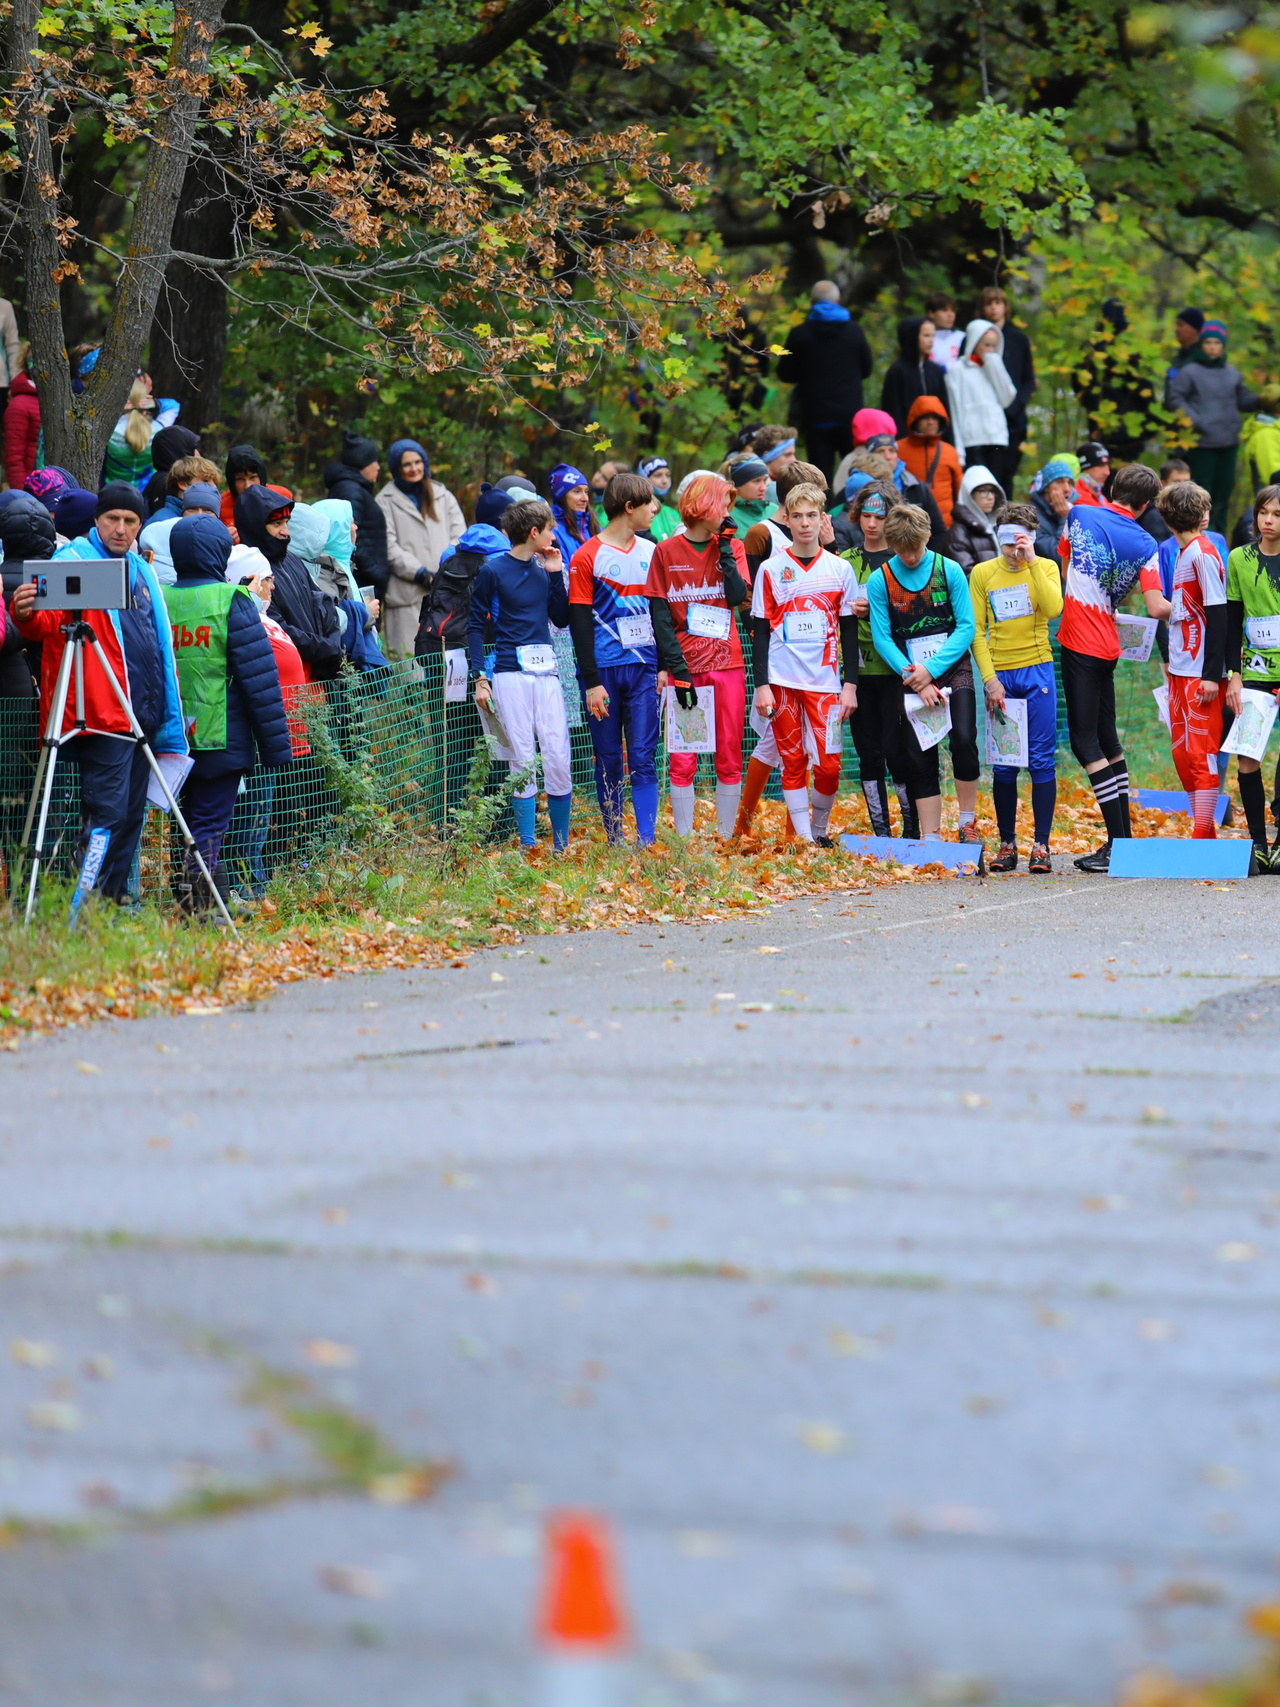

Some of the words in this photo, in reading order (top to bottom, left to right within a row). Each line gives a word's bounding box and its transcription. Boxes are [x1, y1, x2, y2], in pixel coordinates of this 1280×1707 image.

[1004, 600, 1019, 610] 217
[629, 627, 642, 637] 223
[797, 623, 813, 631] 220
[1257, 629, 1271, 638] 214
[923, 649, 936, 659] 218
[531, 656, 544, 665] 224
[81, 833, 107, 891] RUSSIA
